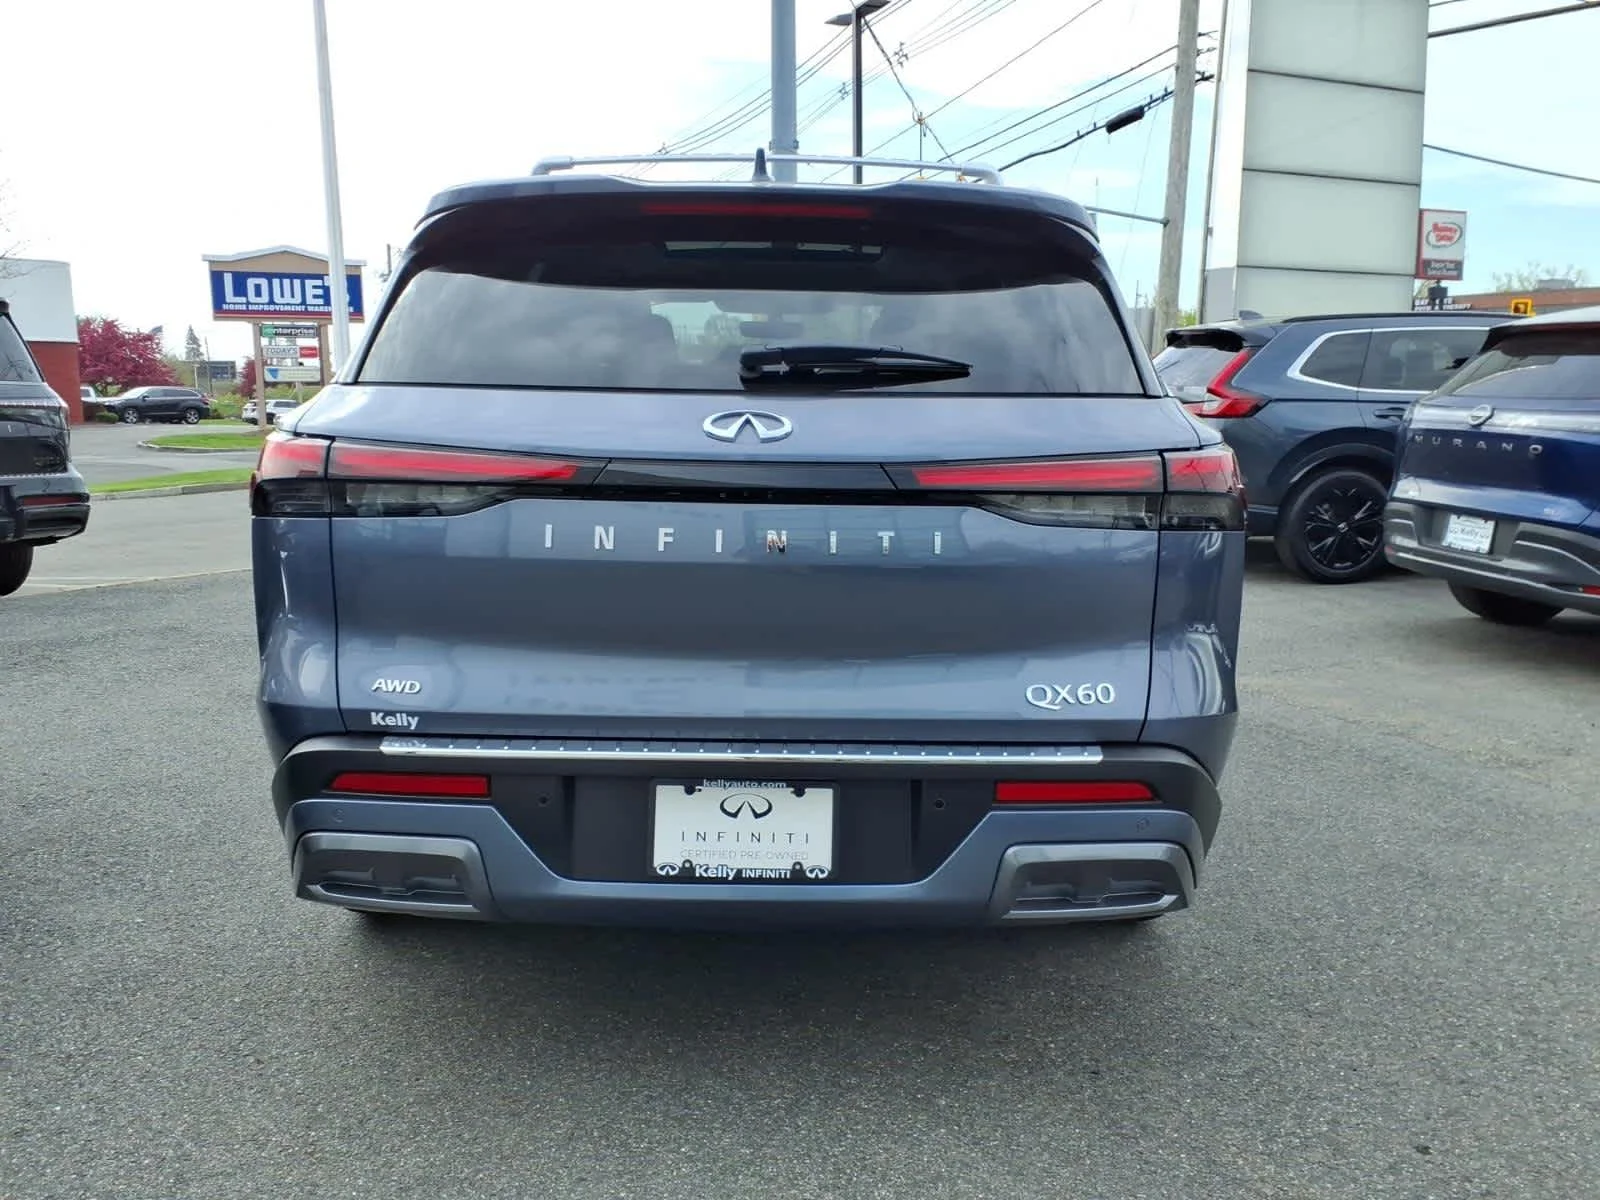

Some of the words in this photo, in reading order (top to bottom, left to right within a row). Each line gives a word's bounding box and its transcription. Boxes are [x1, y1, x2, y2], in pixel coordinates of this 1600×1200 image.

[223, 272, 349, 304] LOWE'
[1414, 435, 1543, 454] MURANO
[544, 523, 941, 555] INFINITI
[371, 678, 422, 694] AWD
[1025, 682, 1116, 711] QX60
[370, 711, 420, 730] Kelly
[703, 779, 787, 790] kellyauto.com
[681, 831, 809, 844] INFINITI
[680, 849, 737, 859] CERTIFIED
[695, 863, 737, 880] Kelly
[742, 868, 791, 879] INFINITI
